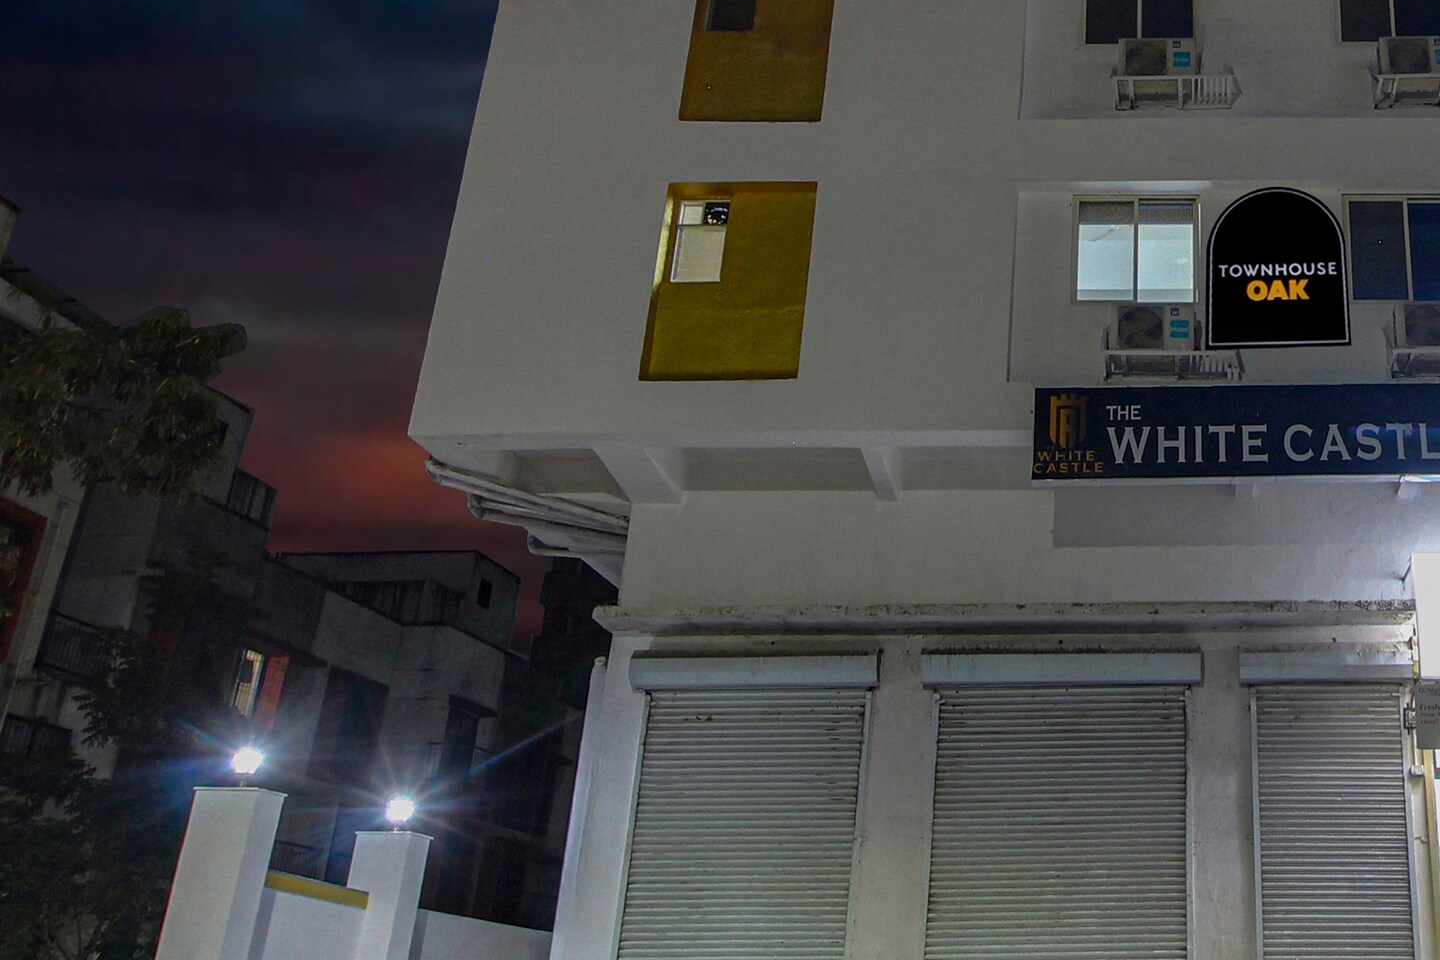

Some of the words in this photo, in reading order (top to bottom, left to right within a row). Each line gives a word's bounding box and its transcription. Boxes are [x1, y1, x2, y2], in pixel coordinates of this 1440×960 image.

[1218, 262, 1338, 278] TOWNHOUSE
[1246, 279, 1310, 302] OAK
[1106, 405, 1142, 421] THE
[1106, 423, 1270, 464] WHITE
[1037, 450, 1096, 462] WHITE
[1033, 462, 1104, 474] CASTLE
[1420, 703, 1440, 711] Fresh
